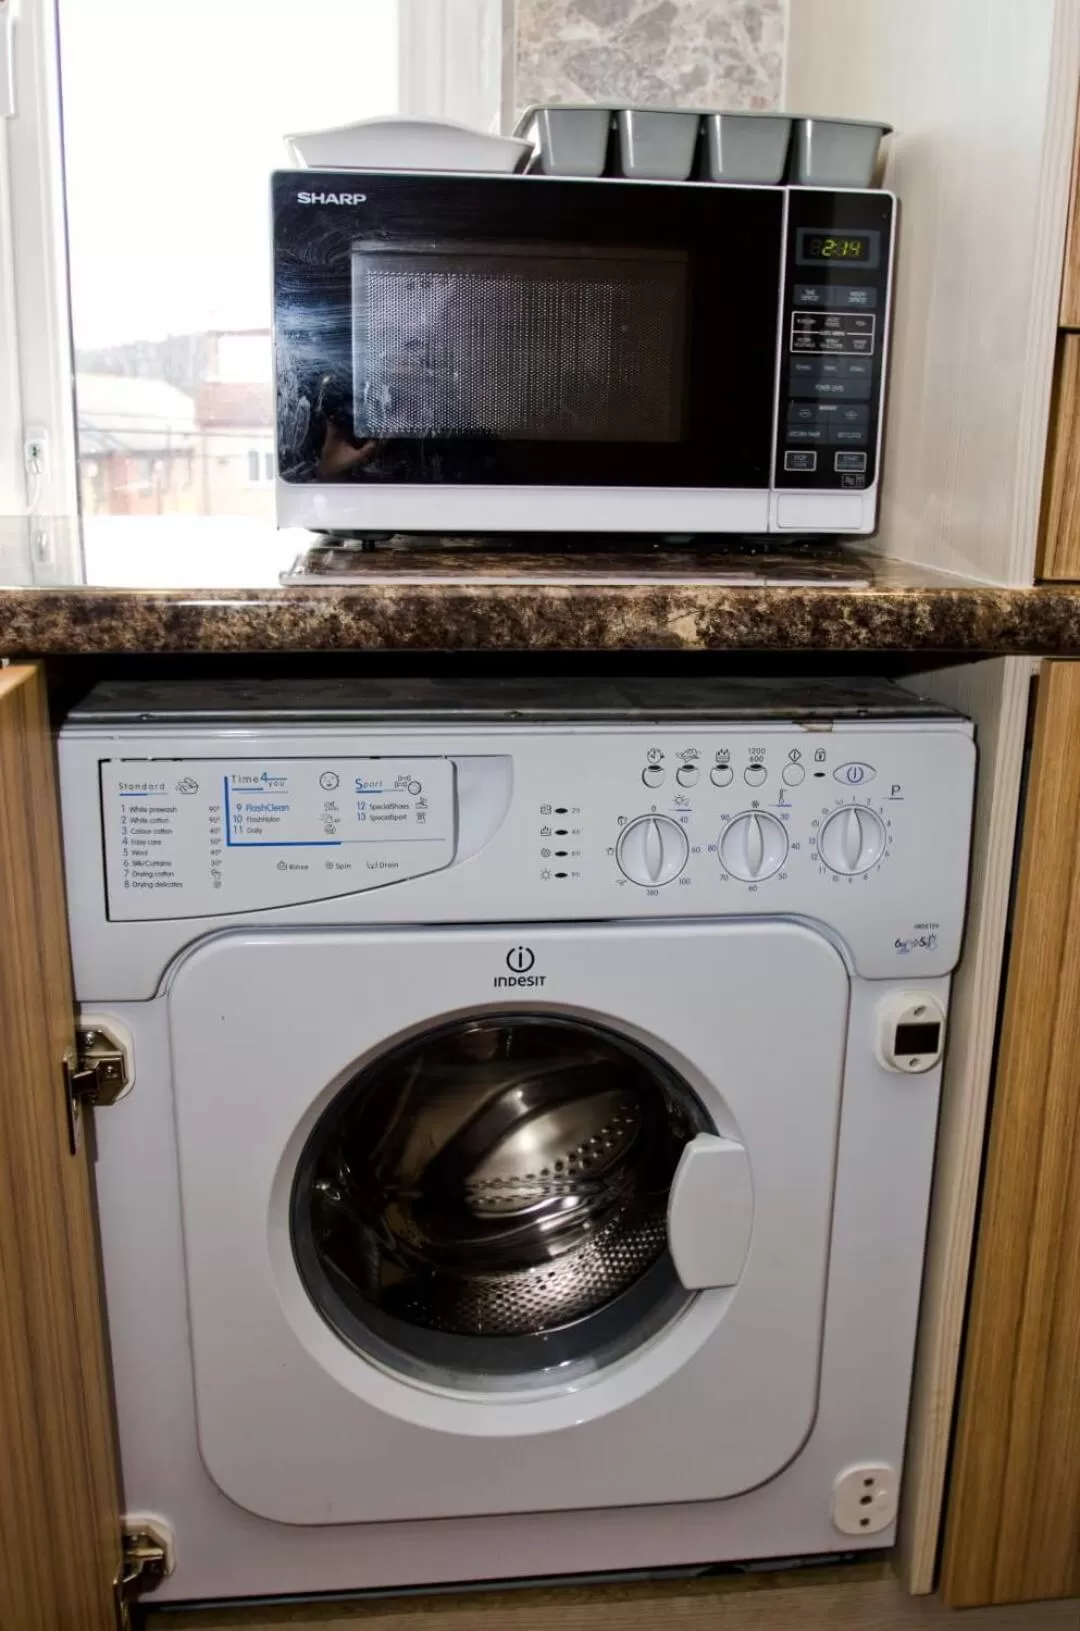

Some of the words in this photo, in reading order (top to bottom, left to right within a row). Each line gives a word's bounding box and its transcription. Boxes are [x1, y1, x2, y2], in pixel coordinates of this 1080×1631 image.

[297, 192, 367, 205] SHARP
[821, 239, 862, 257] 2:14
[118, 782, 165, 791] Standard
[891, 785, 901, 796] P
